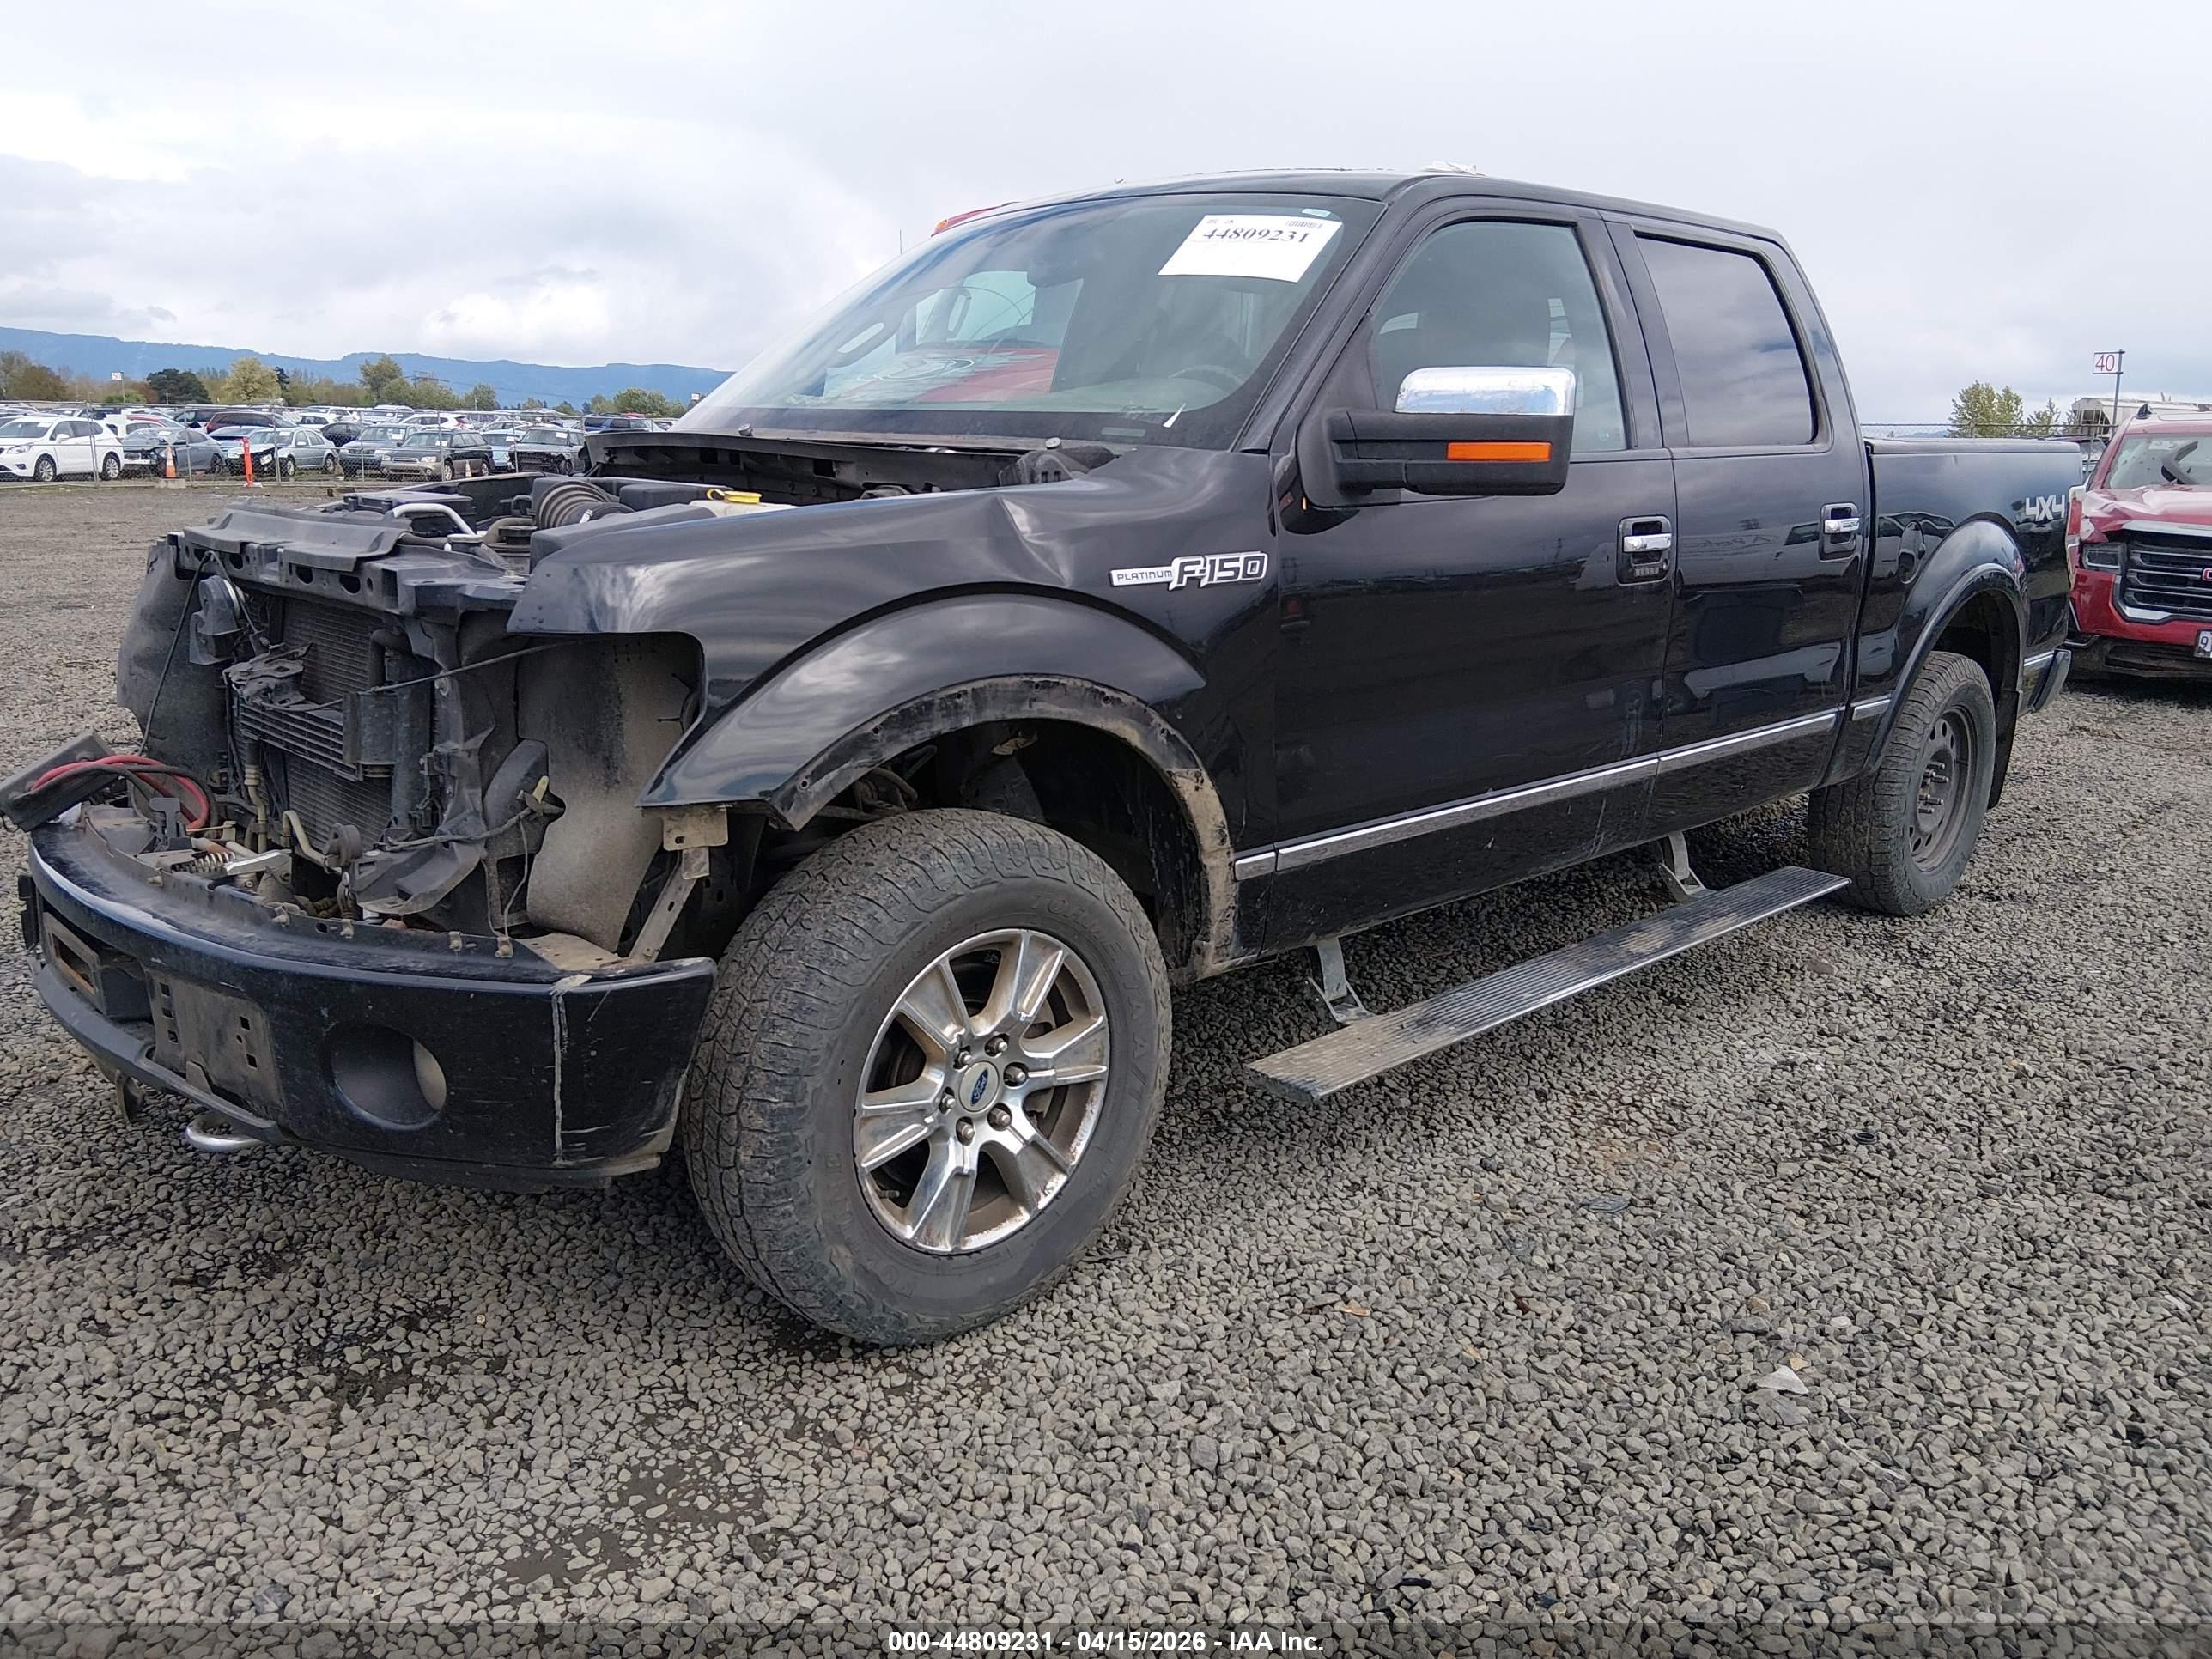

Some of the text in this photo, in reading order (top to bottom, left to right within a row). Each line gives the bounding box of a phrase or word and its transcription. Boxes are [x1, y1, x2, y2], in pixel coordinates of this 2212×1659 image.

[1203, 228, 1310, 243] 44809231
[2095, 354, 2115, 372] 40
[1115, 552, 1268, 590] PLATINUM F-150
